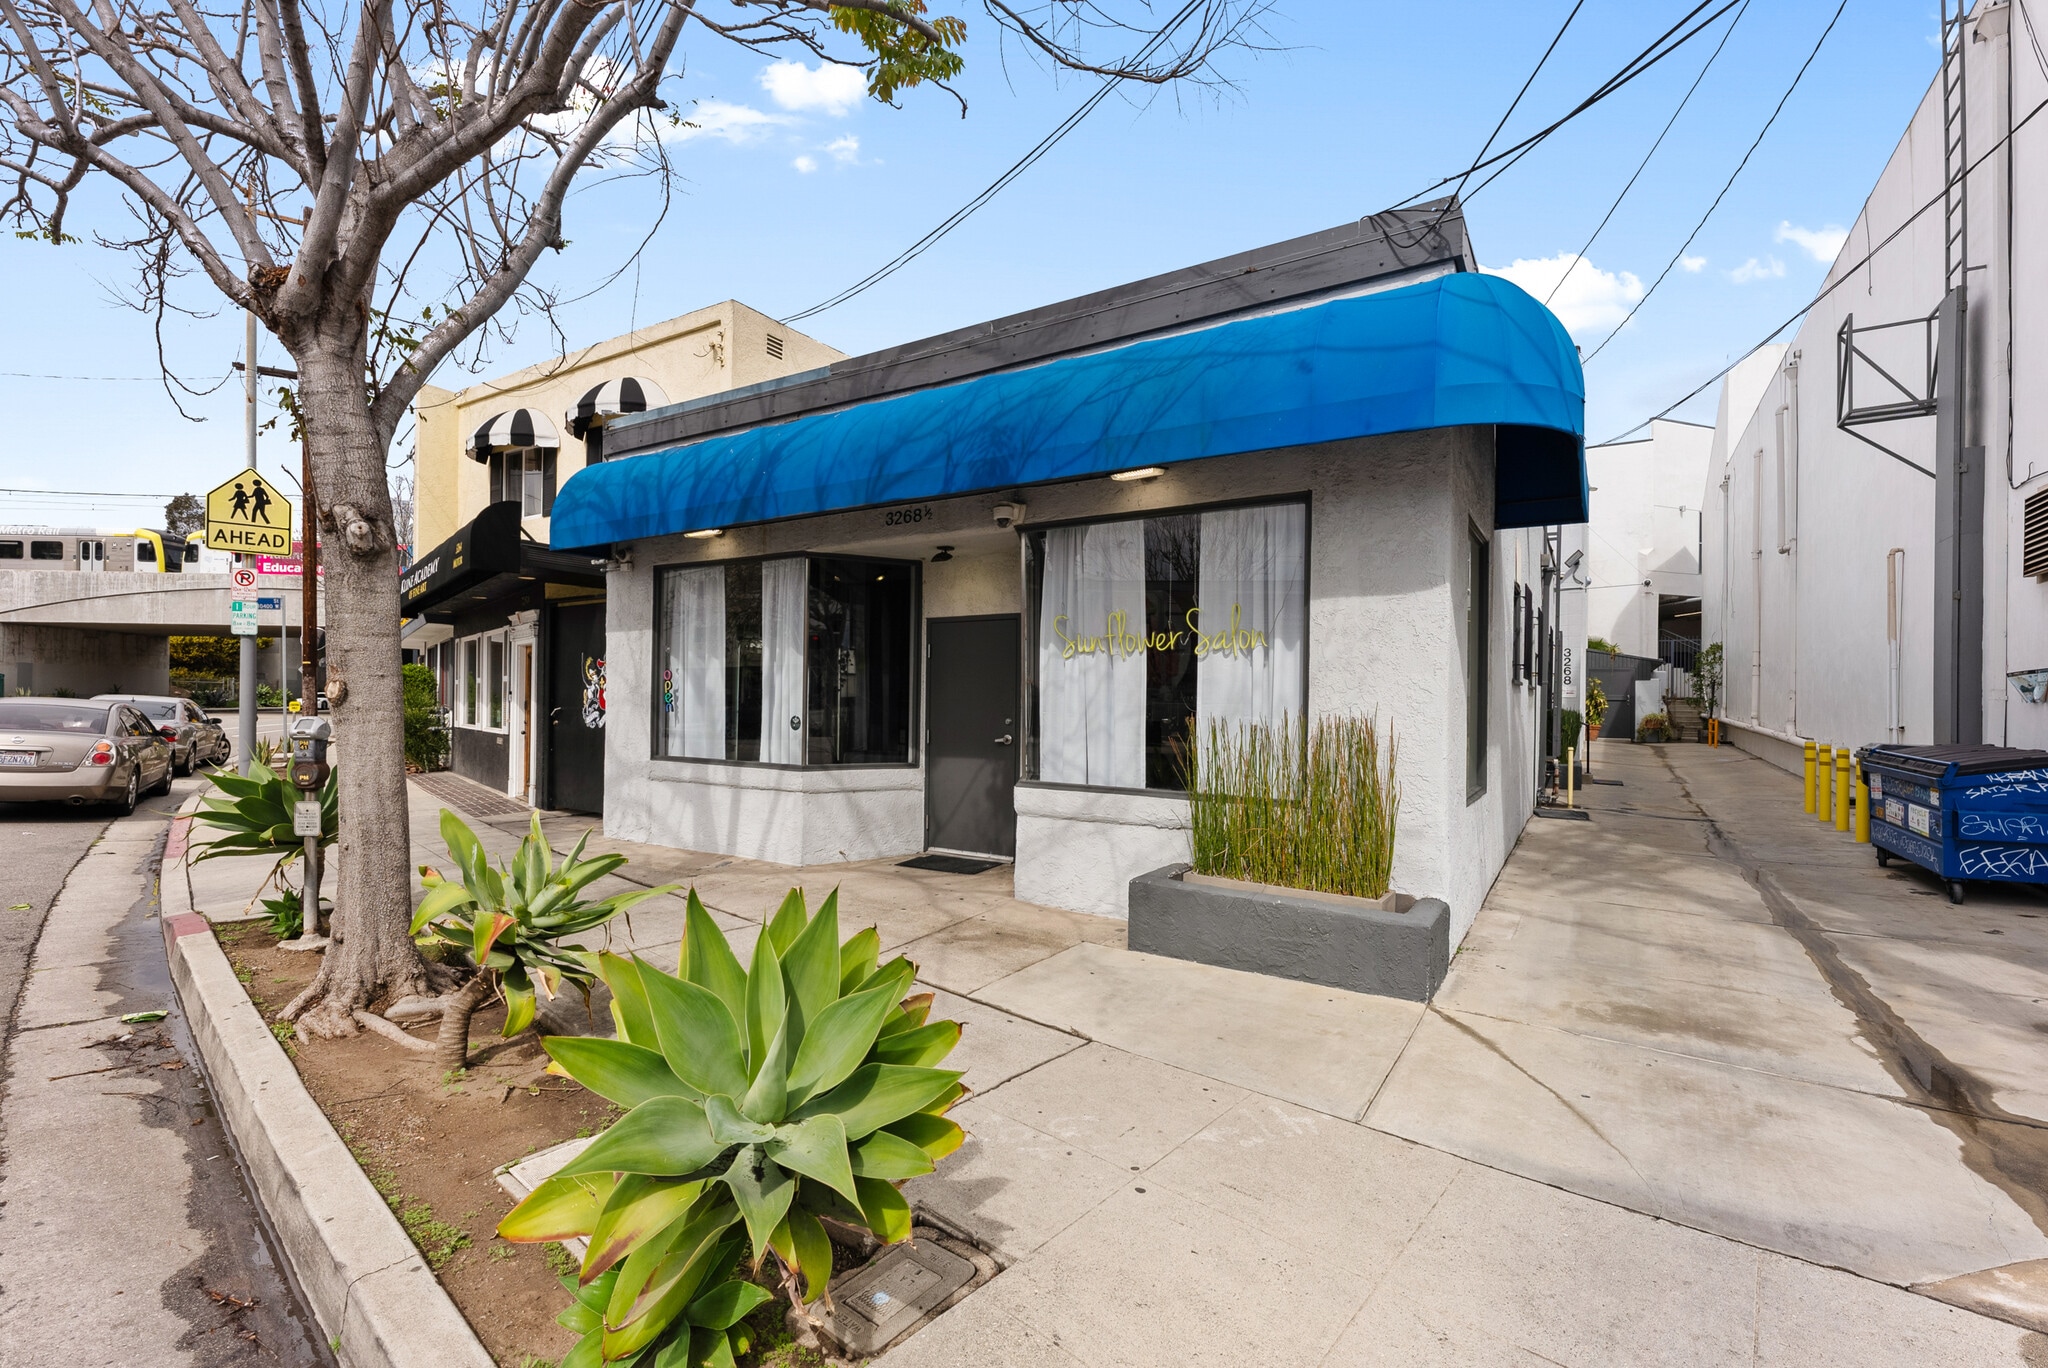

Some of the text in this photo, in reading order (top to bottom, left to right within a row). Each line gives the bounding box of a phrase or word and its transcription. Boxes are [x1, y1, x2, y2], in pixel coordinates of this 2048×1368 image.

[0, 525, 60, 535] Metro Rail
[213, 528, 285, 548] AHEAD
[414, 557, 440, 586] ACADEMY
[1054, 603, 1268, 660] Sunflower Salon
[1563, 648, 1572, 685] 3268
[663, 669, 674, 712] open
[833, 1311, 862, 1334] WATER
